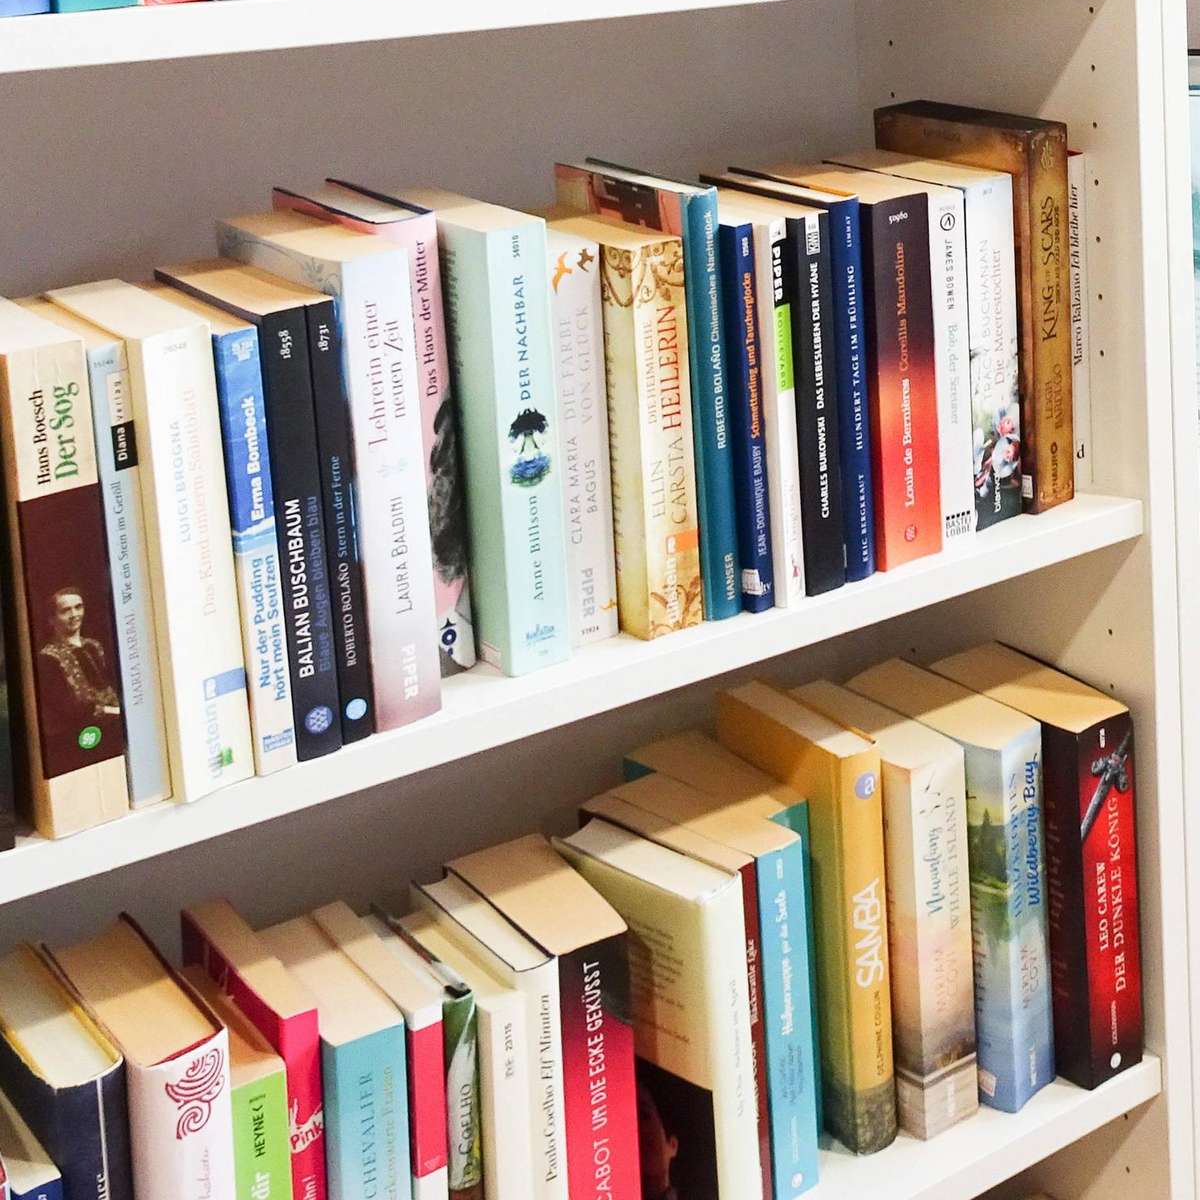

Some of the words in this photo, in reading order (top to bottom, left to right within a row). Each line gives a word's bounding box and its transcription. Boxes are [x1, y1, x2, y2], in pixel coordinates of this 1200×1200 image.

[1066, 183, 1080, 210] hier
[1039, 196, 1057, 266] SCARS
[1067, 210, 1081, 247] bleibe
[414, 239, 431, 294] Mütter
[808, 262, 820, 298] HYÄNE
[892, 242, 908, 316] Mandoline
[1068, 250, 1081, 270] Ich
[417, 298, 431, 322] der
[512, 274, 530, 362] NACHBAR
[810, 301, 822, 322] DER
[844, 265, 859, 330] FRÜHLING
[1041, 285, 1058, 343] KING
[1069, 273, 1083, 323] Balzano
[420, 328, 436, 367] Haus
[812, 323, 826, 386] LIEBESLEBEN
[849, 335, 860, 350] IM
[895, 318, 909, 372] Corellis
[1071, 326, 1084, 366] Marco
[424, 369, 438, 397] Das
[518, 368, 532, 401] DER
[656, 304, 683, 432] HEILERIN
[850, 355, 862, 387] TAGE
[30, 389, 48, 445] Boesch
[48, 382, 80, 430] Sog
[814, 388, 825, 410] DAS
[852, 392, 865, 450] HUNDERT
[897, 378, 913, 443] Bernières
[52, 434, 79, 480] Der
[117, 426, 129, 461] Diana
[242, 396, 262, 474] Bombeck
[816, 416, 829, 472] BUKOWSKI
[901, 448, 913, 465] de
[36, 447, 52, 485] Hans
[330, 455, 342, 488] Ferne
[902, 468, 916, 508] Louis
[249, 477, 266, 521] Erma
[331, 491, 344, 510] der
[333, 511, 344, 519] in
[819, 474, 831, 518] CHARLES
[334, 526, 349, 558] Stern
[525, 494, 543, 555] Billson
[284, 498, 308, 609] BUSCHBAUM
[251, 557, 268, 625] Pudding
[263, 554, 281, 621] Seufzen
[337, 561, 353, 611] BOLAÑO
[530, 559, 546, 602] Anne
[253, 629, 269, 654] der
[268, 623, 284, 664] mein
[295, 613, 315, 679] BALIAN
[342, 613, 358, 667] ROBERTO
[257, 659, 273, 688] Nur
[271, 667, 287, 702] hört
[1022, 752, 1039, 803] Bay
[1104, 795, 1122, 862] KÖNIG
[1024, 805, 1042, 906] Wildberry
[1095, 861, 1108, 916] CAREW
[1110, 866, 1126, 949] DUNKLE
[852, 876, 884, 989] SAMBA
[1097, 920, 1109, 951] LEO
[1113, 952, 1128, 991] DER
[581, 960, 605, 1033] GEKÜSST
[587, 1035, 606, 1077] ECKE
[589, 1079, 607, 1105] DIE
[252, 1113, 266, 1158] HEYNE
[291, 1122, 322, 1150] Pink
[591, 1108, 608, 1132] UM
